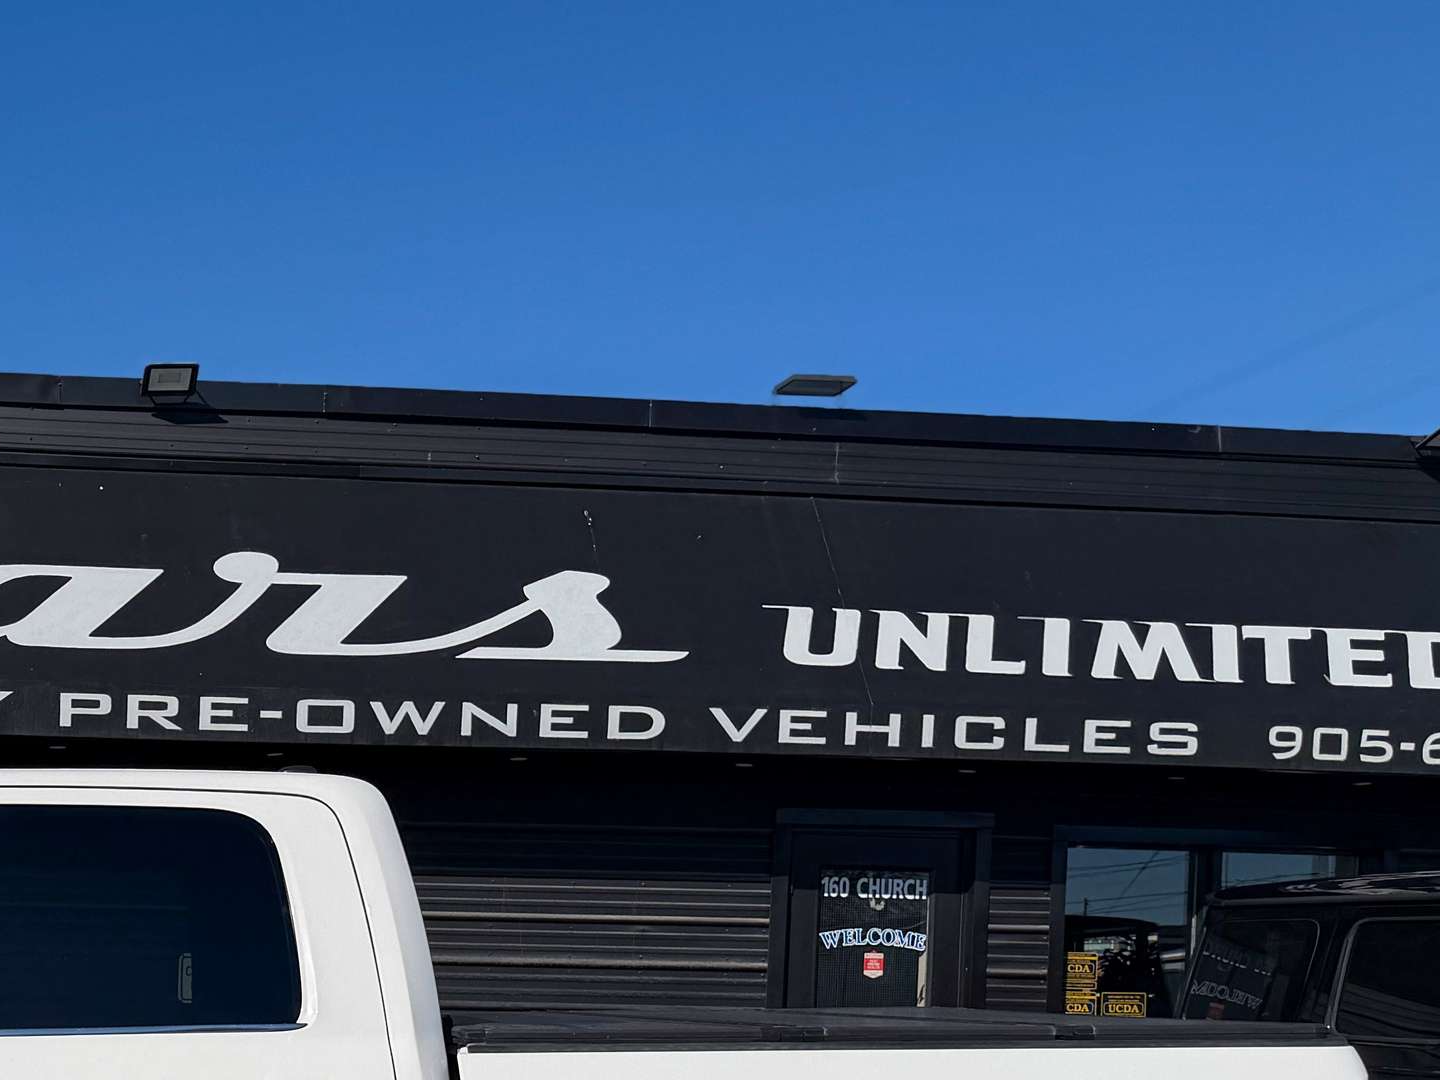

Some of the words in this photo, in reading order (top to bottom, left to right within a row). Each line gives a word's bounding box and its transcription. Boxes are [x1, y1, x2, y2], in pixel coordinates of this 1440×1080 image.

[59, 692, 666, 740] PRE-OWNED
[708, 707, 1199, 756] VEHICLES
[821, 876, 850, 898] 160
[856, 877, 928, 900] CHURCH
[819, 927, 927, 951] WELCOME
[1067, 964, 1090, 973] CDA
[1066, 1003, 1089, 1012] CDA
[1108, 1004, 1140, 1013] UCDA
